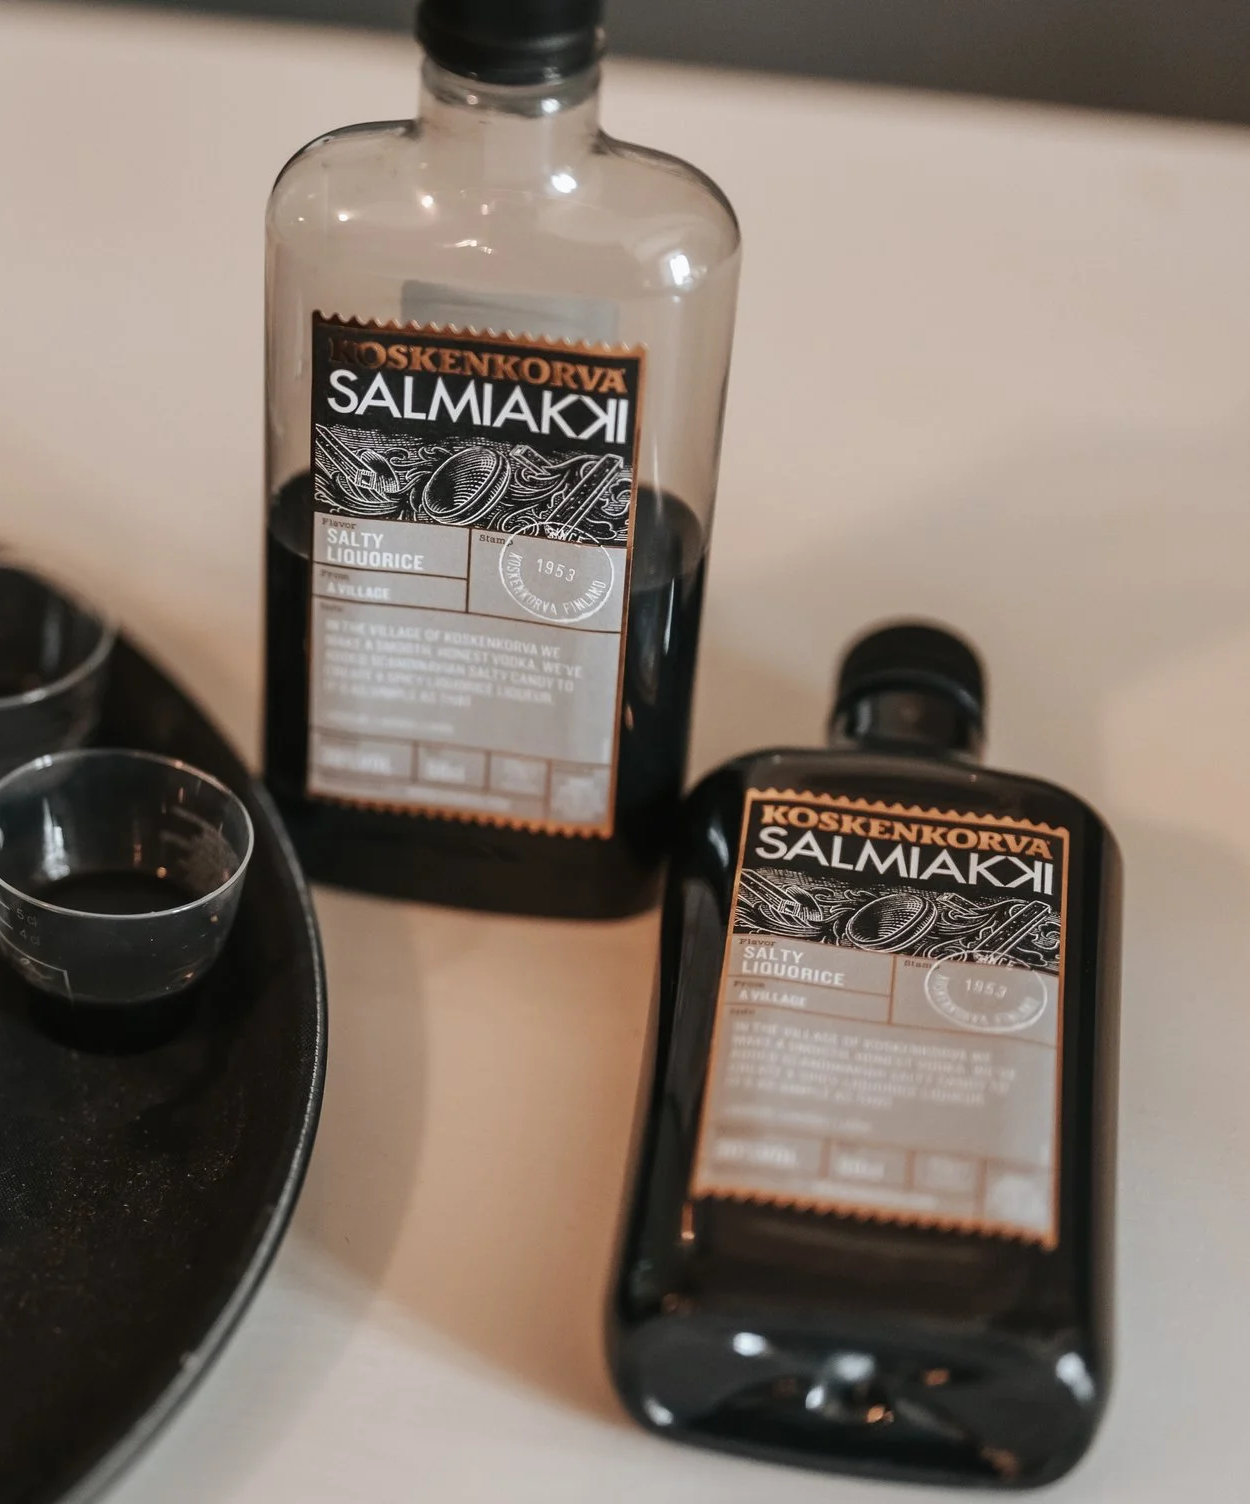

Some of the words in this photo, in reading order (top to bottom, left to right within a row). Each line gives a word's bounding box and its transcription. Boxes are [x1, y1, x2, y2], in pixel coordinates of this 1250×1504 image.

[328, 336, 627, 394] KOSKENKORVA
[326, 368, 629, 444] SALMIAKKI
[321, 517, 357, 529] Flavor
[327, 528, 384, 549] SALTY
[326, 546, 425, 571] LIQUORICE
[537, 558, 576, 581] 1953
[327, 582, 336, 593] A
[336, 583, 391, 600] VILLAGE
[759, 804, 1054, 859] KOSKENKORVA
[755, 826, 1055, 896] SALMIAKKI
[738, 938, 777, 947] Flavor
[743, 945, 804, 964] SALTY
[741, 960, 846, 986] LIQUORICE
